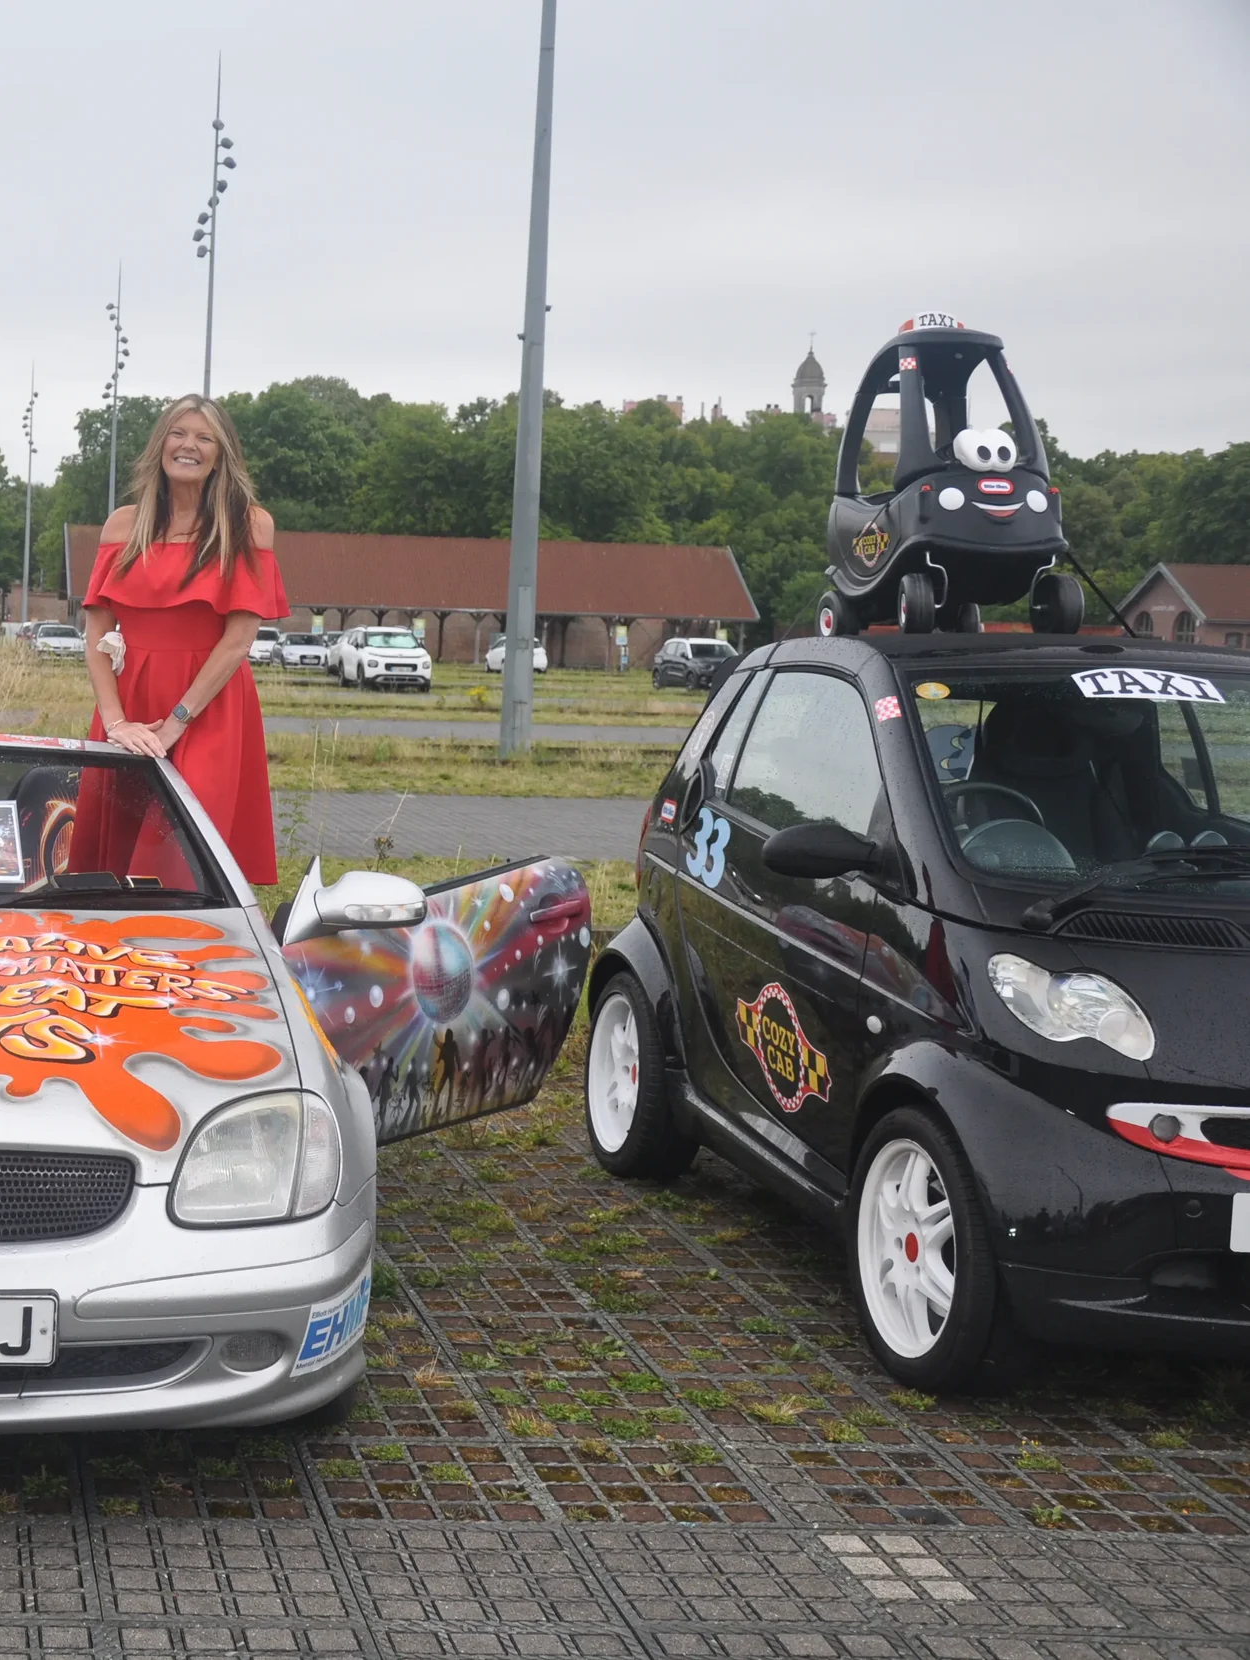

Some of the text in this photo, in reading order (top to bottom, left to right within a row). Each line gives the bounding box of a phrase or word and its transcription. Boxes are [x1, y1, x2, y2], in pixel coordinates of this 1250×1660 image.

[919, 313, 954, 328] TAXI
[1080, 670, 1220, 702] TAXI
[686, 807, 731, 888] 33
[762, 1015, 796, 1057] COZY
[767, 1044, 795, 1083] CAB
